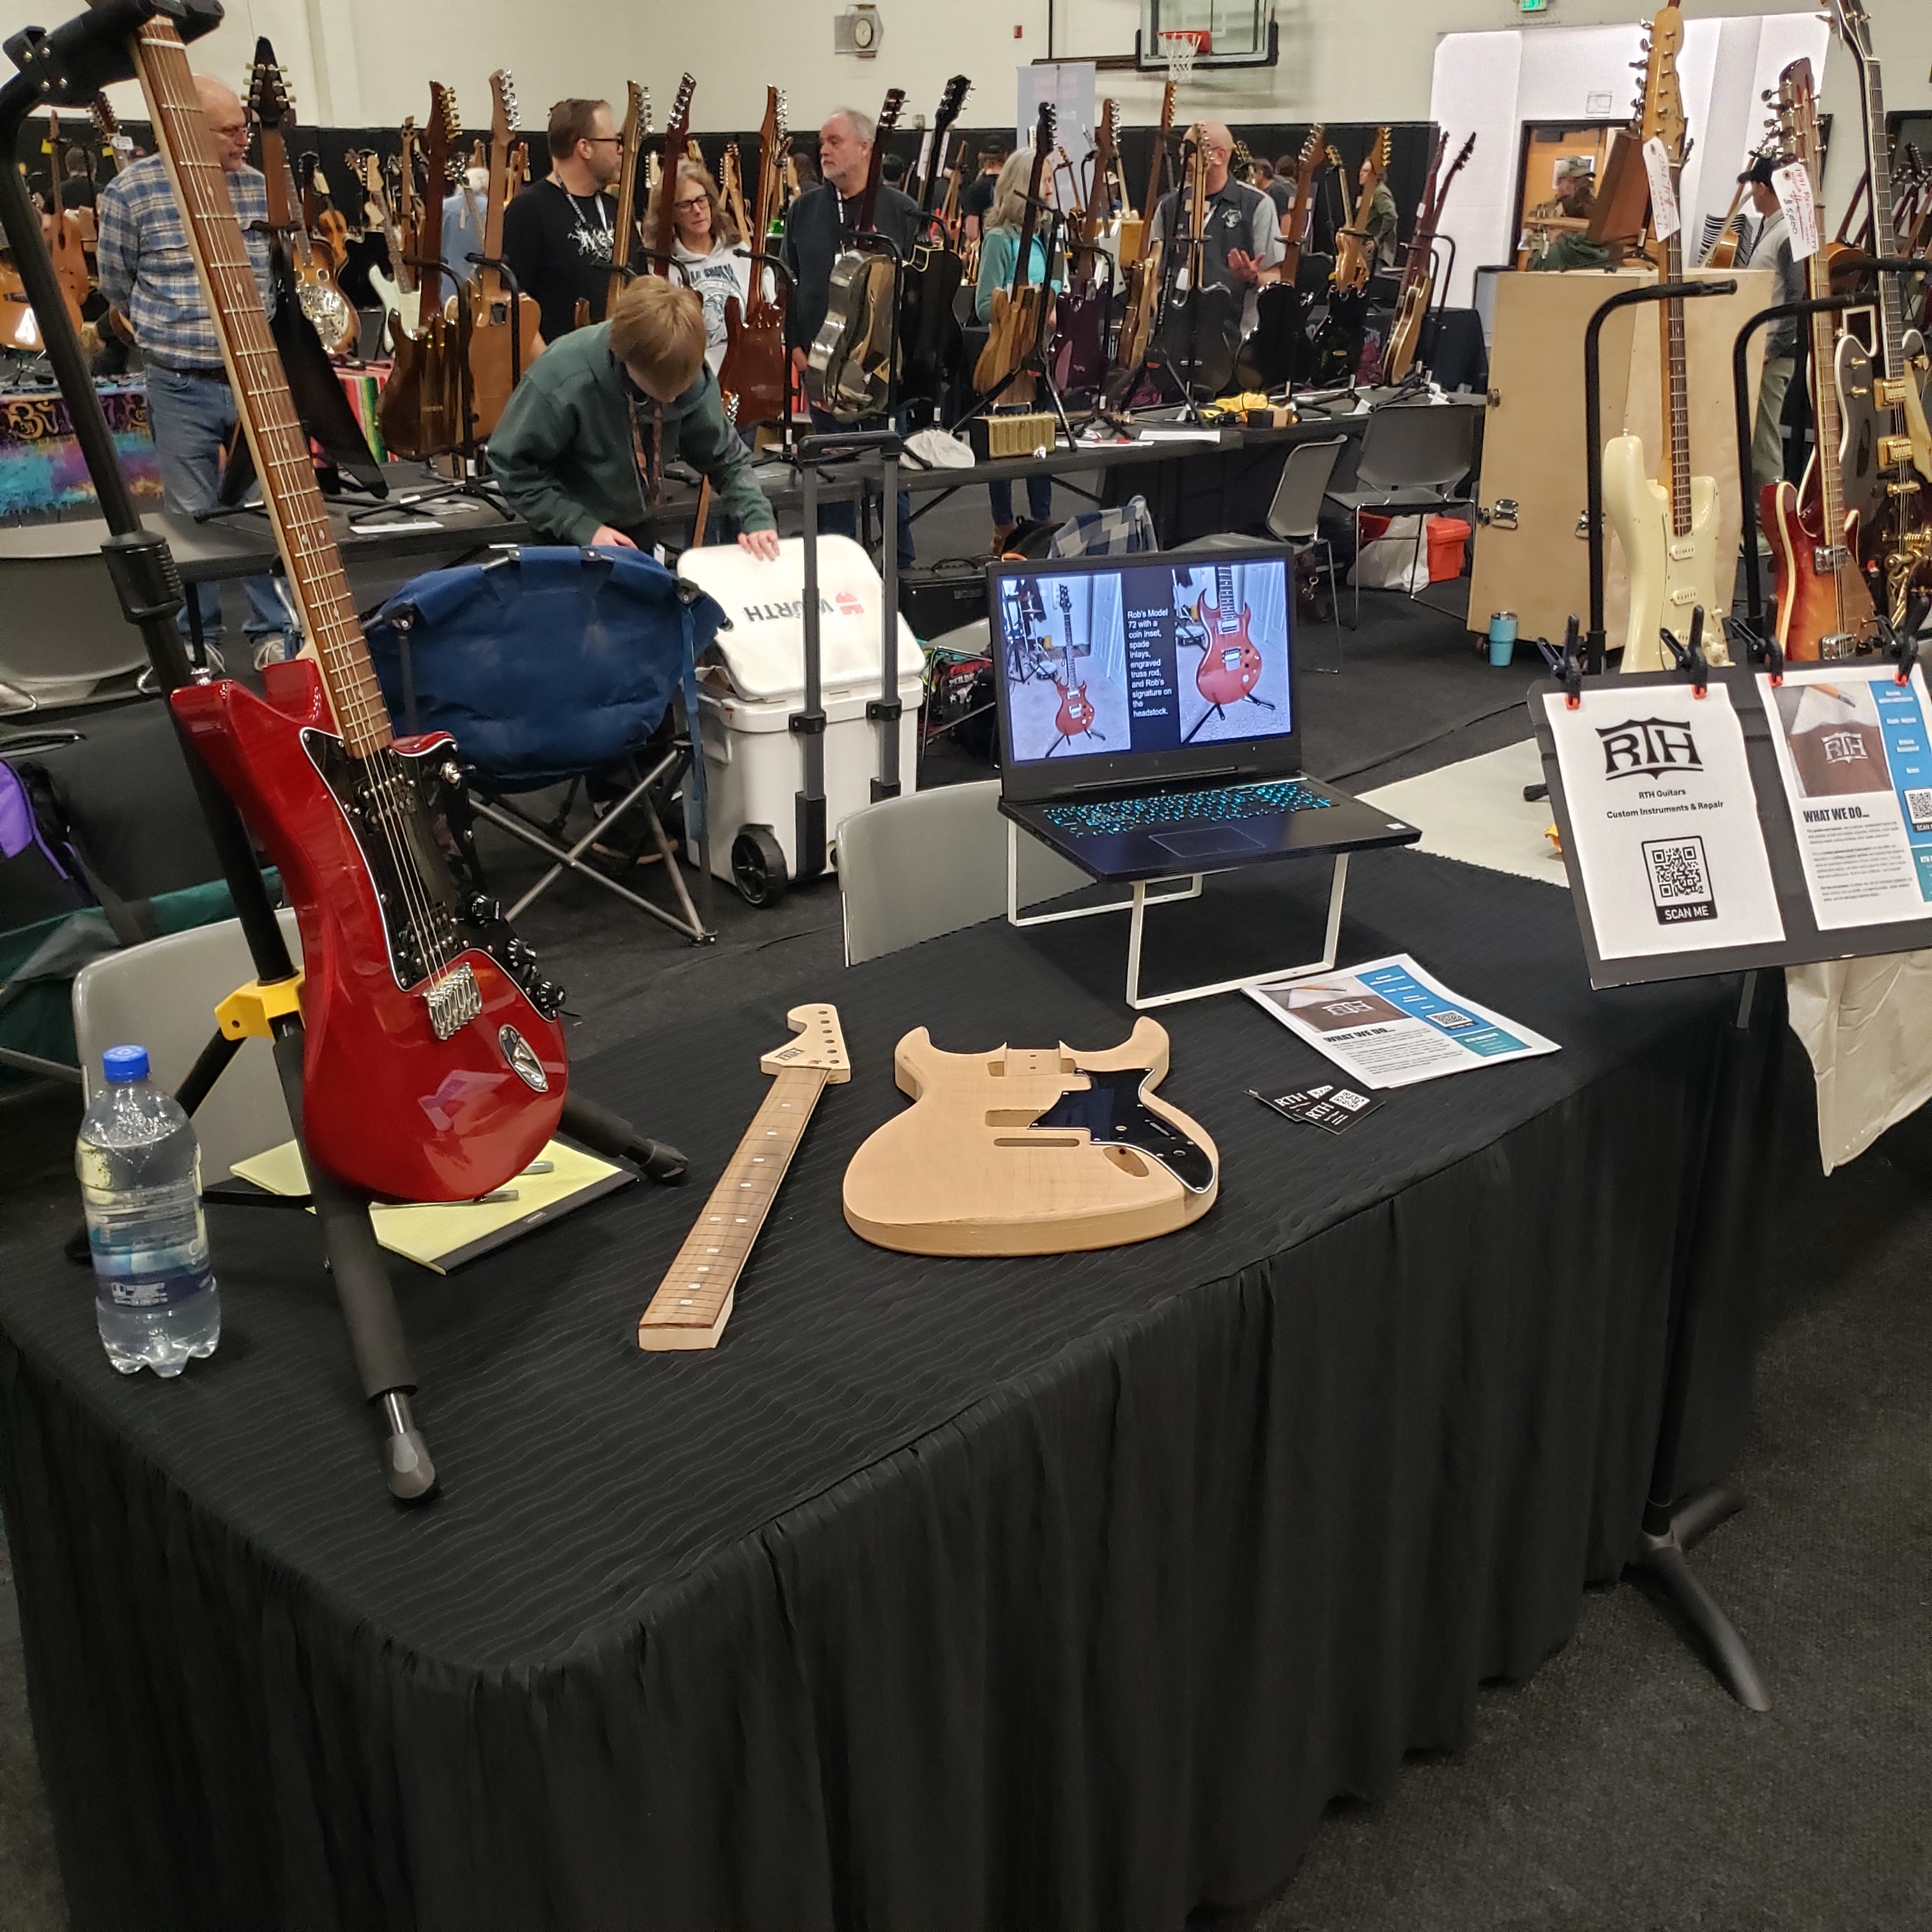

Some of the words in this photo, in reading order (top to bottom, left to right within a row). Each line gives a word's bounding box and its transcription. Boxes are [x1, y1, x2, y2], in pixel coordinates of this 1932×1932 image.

[1128, 611, 1146, 619] Rob's
[1148, 609, 1168, 617] Model
[1144, 629, 1162, 638] inset,
[1130, 641, 1149, 650] spade
[1130, 651, 1151, 659] inlays,
[1130, 659, 1161, 669] engraved
[1131, 680, 1144, 688] and
[1132, 690, 1162, 699] signature
[1133, 708, 1169, 718] headstock.
[1595, 717, 1703, 778] RTH
[1821, 732, 1868, 762] RTH
[1657, 789, 1686, 797] Guitars
[1607, 810, 1638, 818] Custom
[1640, 804, 1689, 815] Instruments
[1698, 801, 1724, 810] Repair
[1803, 809, 1830, 822] WHAT
[1831, 808, 1848, 820] WE
[1665, 907, 1692, 920] SCAN
[1693, 905, 1709, 917] ME
[1322, 1034, 1354, 1042] WHAT
[1274, 1092, 1308, 1107] RTH
[1305, 1101, 1334, 1119] RTH
